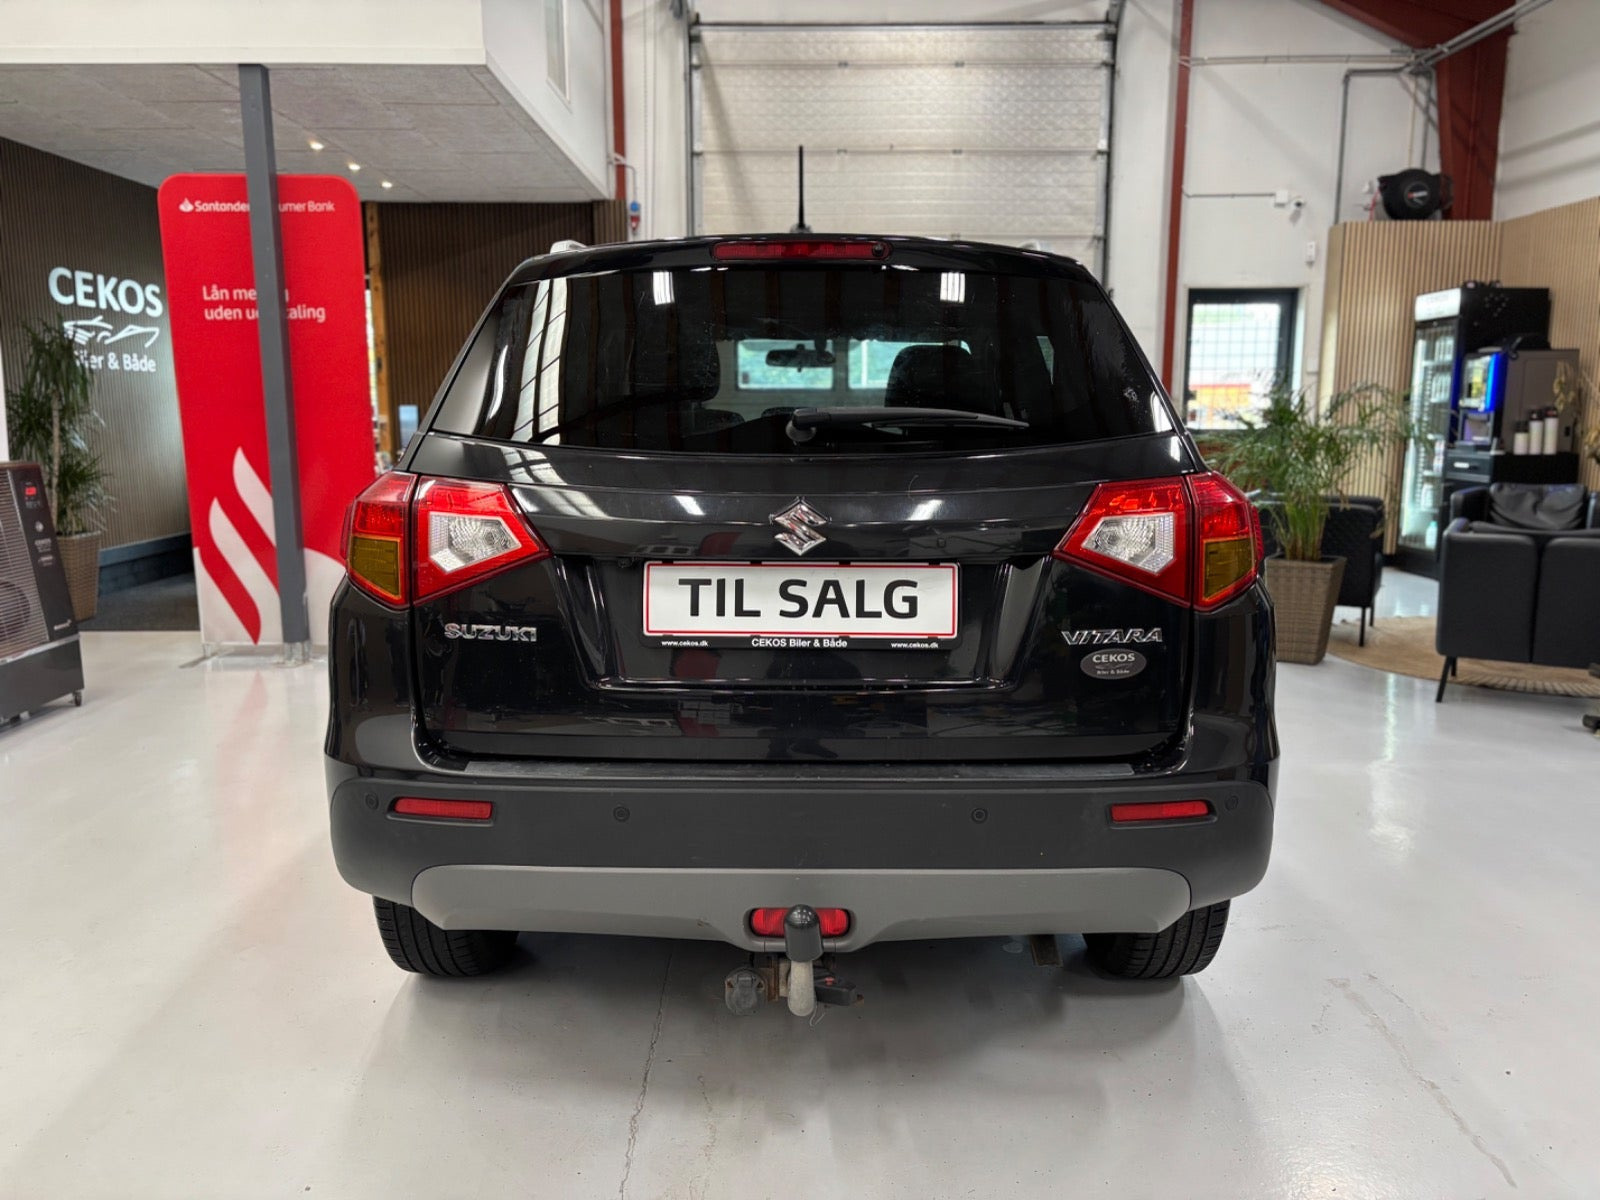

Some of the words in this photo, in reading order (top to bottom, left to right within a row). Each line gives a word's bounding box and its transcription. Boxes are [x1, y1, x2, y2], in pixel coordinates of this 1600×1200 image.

[307, 200, 335, 213] Bank
[47, 266, 164, 318] CEKOS
[202, 284, 230, 301] Lån
[232, 288, 258, 301] me
[204, 305, 242, 320] uden
[107, 352, 120, 370] &
[122, 352, 157, 373] Både
[678, 578, 761, 618] TIL
[778, 578, 919, 619] SALG
[444, 622, 538, 643] SUZUKI
[1061, 627, 1164, 646] VITARA
[661, 639, 709, 648] www.cekos.dk
[751, 638, 787, 648] CEKOS
[789, 638, 811, 648] Biler
[812, 638, 821, 648] &
[822, 637, 848, 648] Både
[890, 641, 939, 650] www.cekos.dk
[1092, 652, 1136, 663] CEKOS
